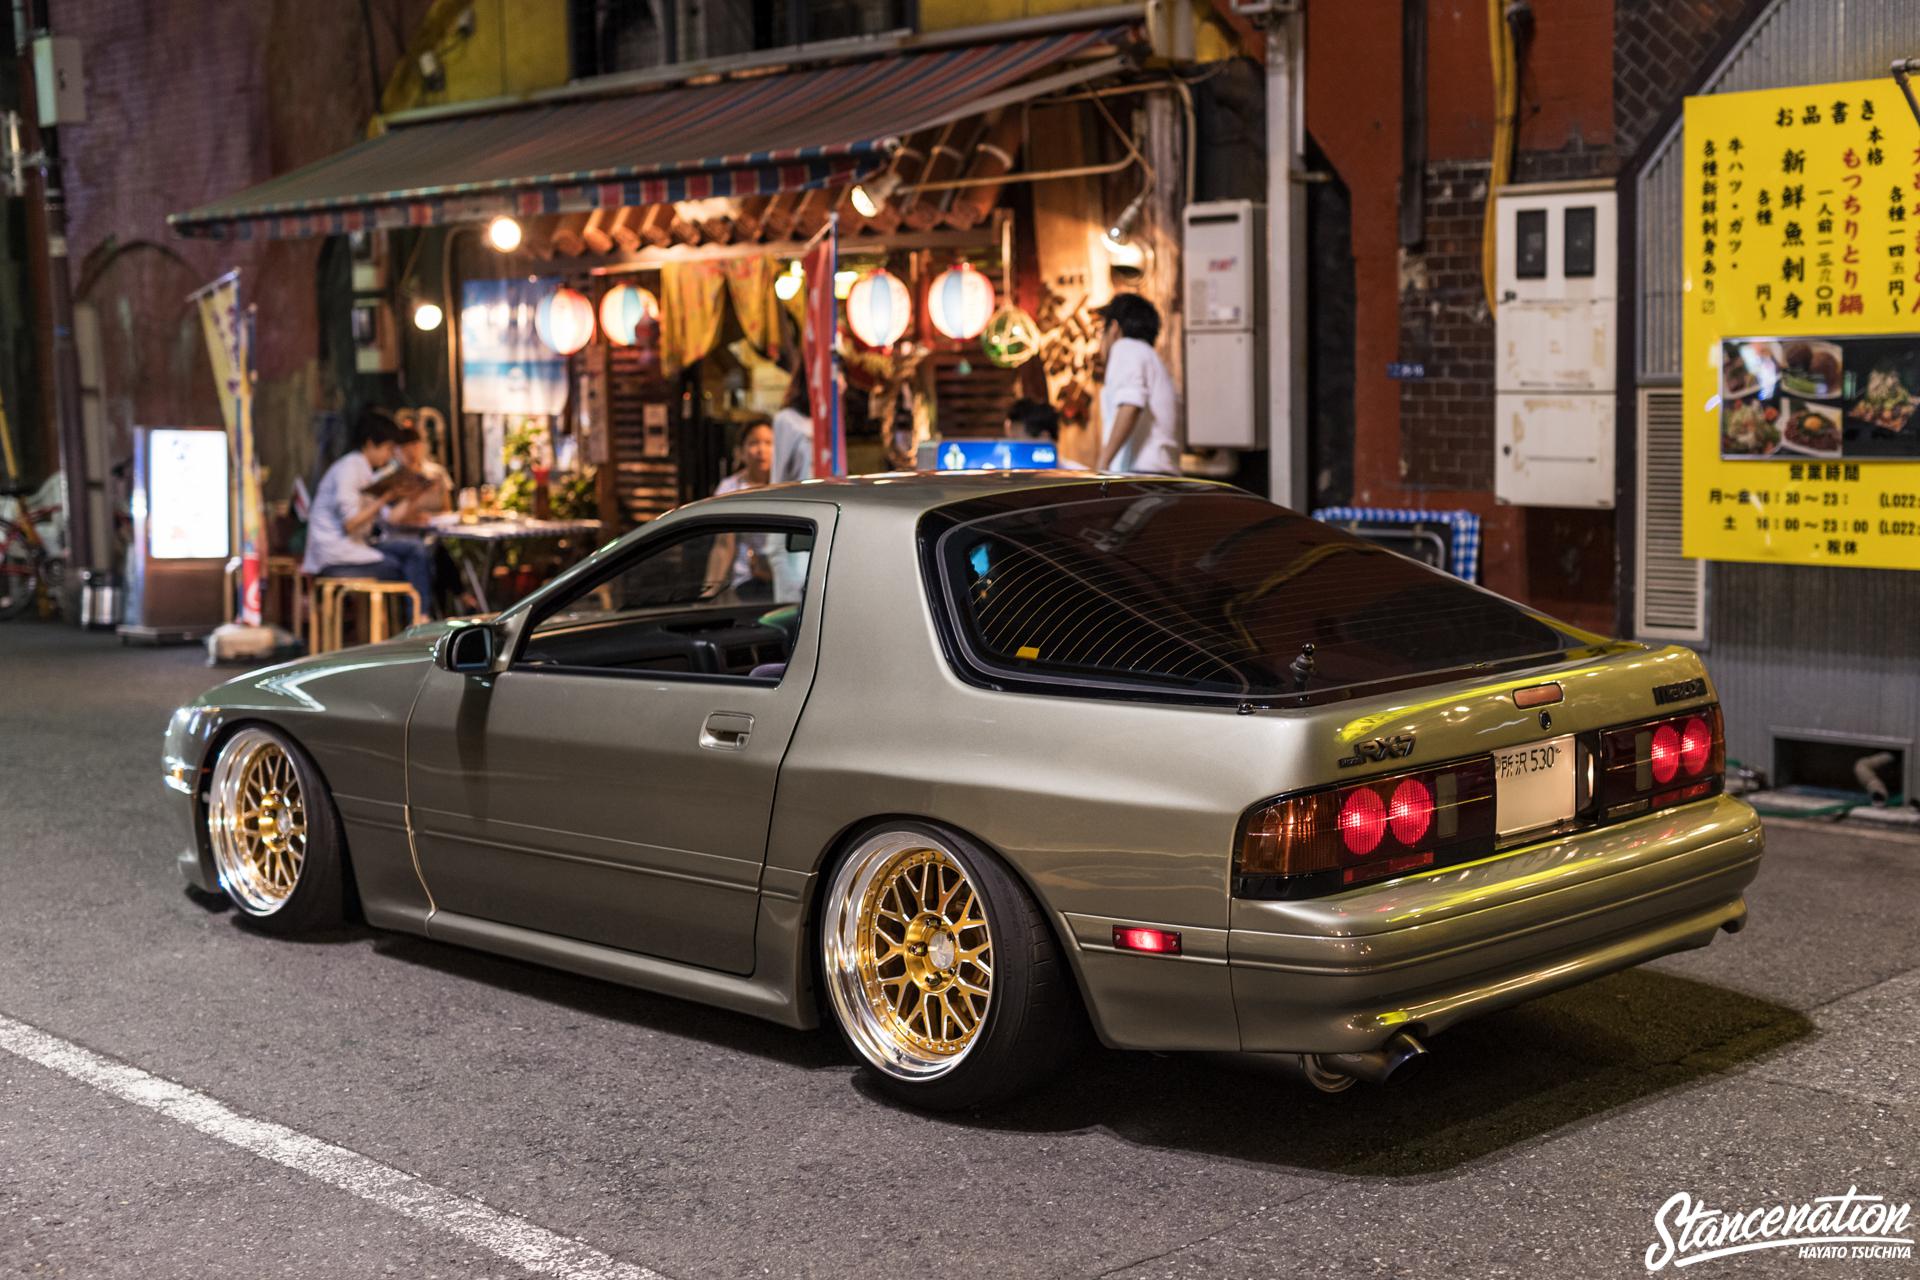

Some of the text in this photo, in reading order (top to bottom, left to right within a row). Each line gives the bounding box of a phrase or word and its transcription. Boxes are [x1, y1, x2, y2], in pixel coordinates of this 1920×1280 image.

[1776, 100, 1875, 127] お品書き
[1867, 126, 1884, 166] 本格
[1756, 189, 1773, 226] 各種
[1781, 149, 1806, 320] 新鮮魚刺身
[1790, 464, 1860, 481] 営業時間
[1723, 516, 1736, 530] 土
[1501, 746, 1554, 778] 所沢 530
